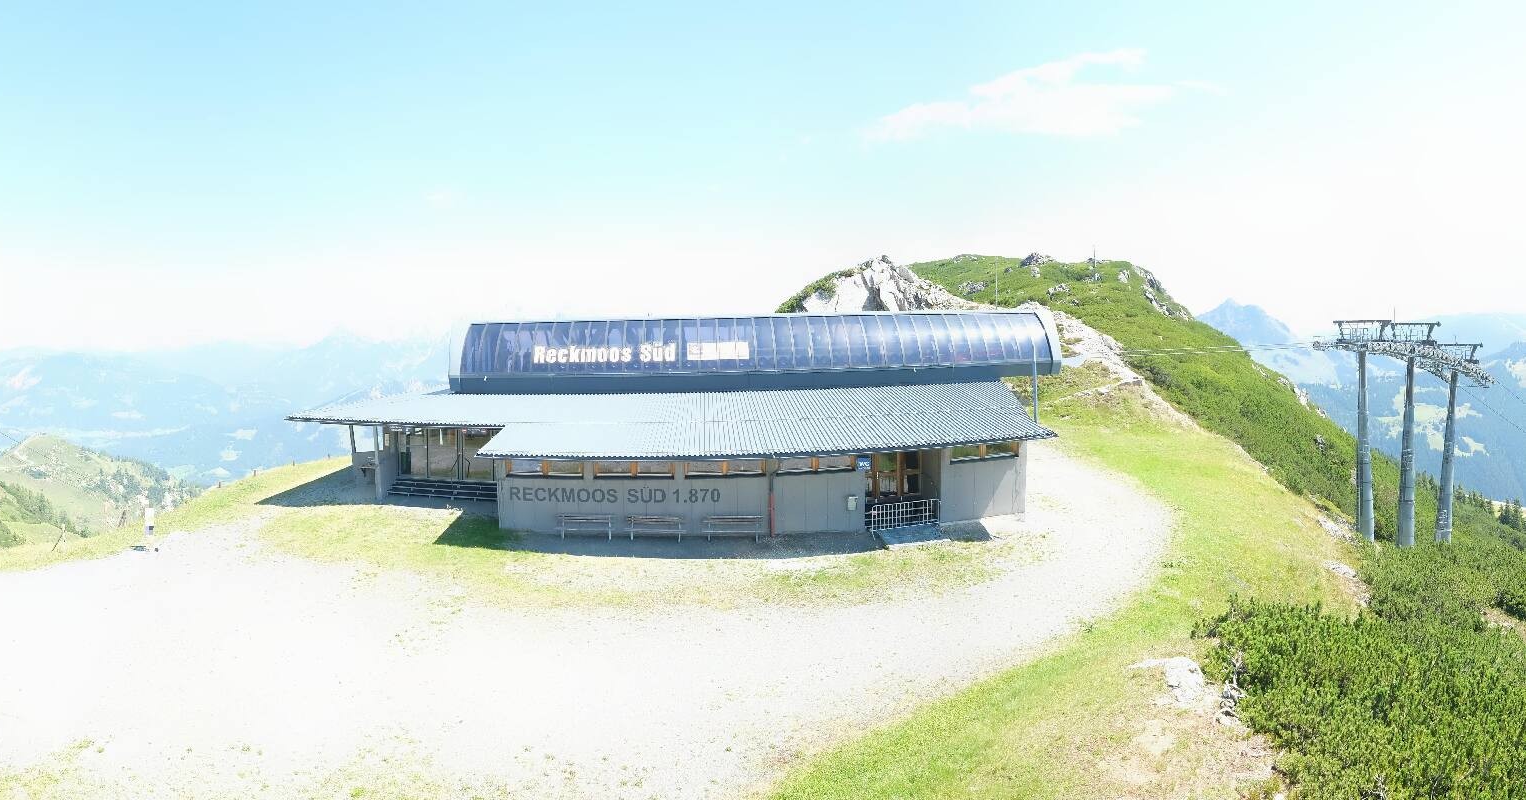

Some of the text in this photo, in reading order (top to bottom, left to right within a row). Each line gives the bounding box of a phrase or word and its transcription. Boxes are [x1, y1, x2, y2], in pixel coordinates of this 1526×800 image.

[533, 340, 676, 364] Reckmoos Süd
[509, 486, 721, 504] RECKMOOS SÜD 1.870
